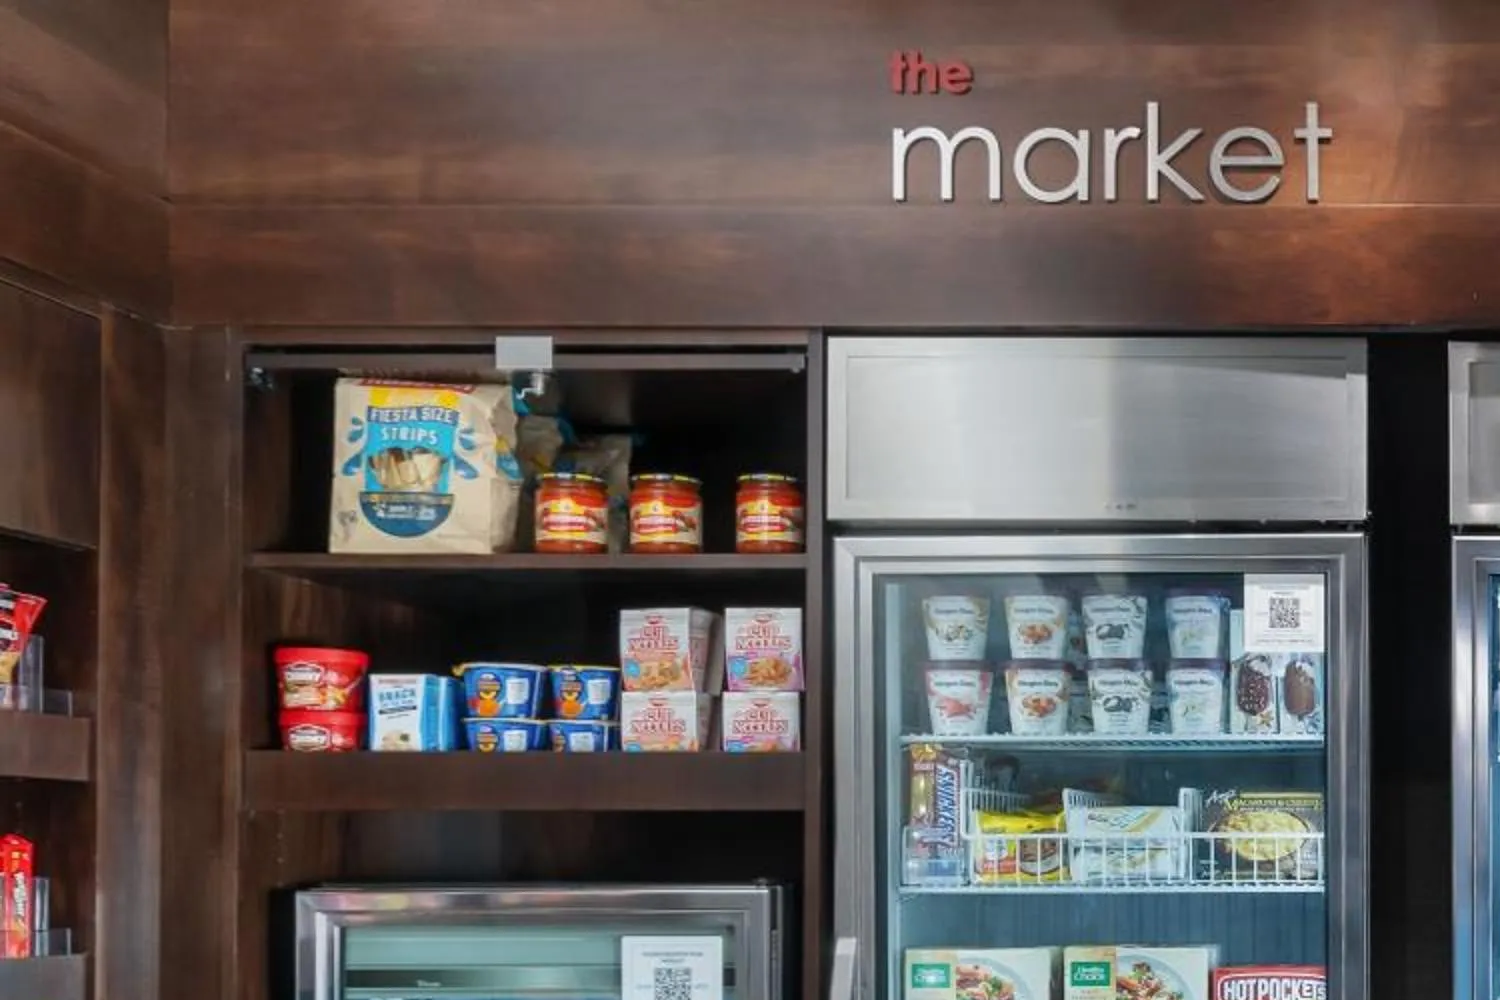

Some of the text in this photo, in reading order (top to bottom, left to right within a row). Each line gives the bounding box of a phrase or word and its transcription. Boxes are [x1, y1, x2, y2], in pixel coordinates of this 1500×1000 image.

[888, 50, 973, 94] the
[892, 101, 1333, 202] market
[370, 407, 452, 424] FIESTA SIZE
[380, 426, 438, 445] STRIPS
